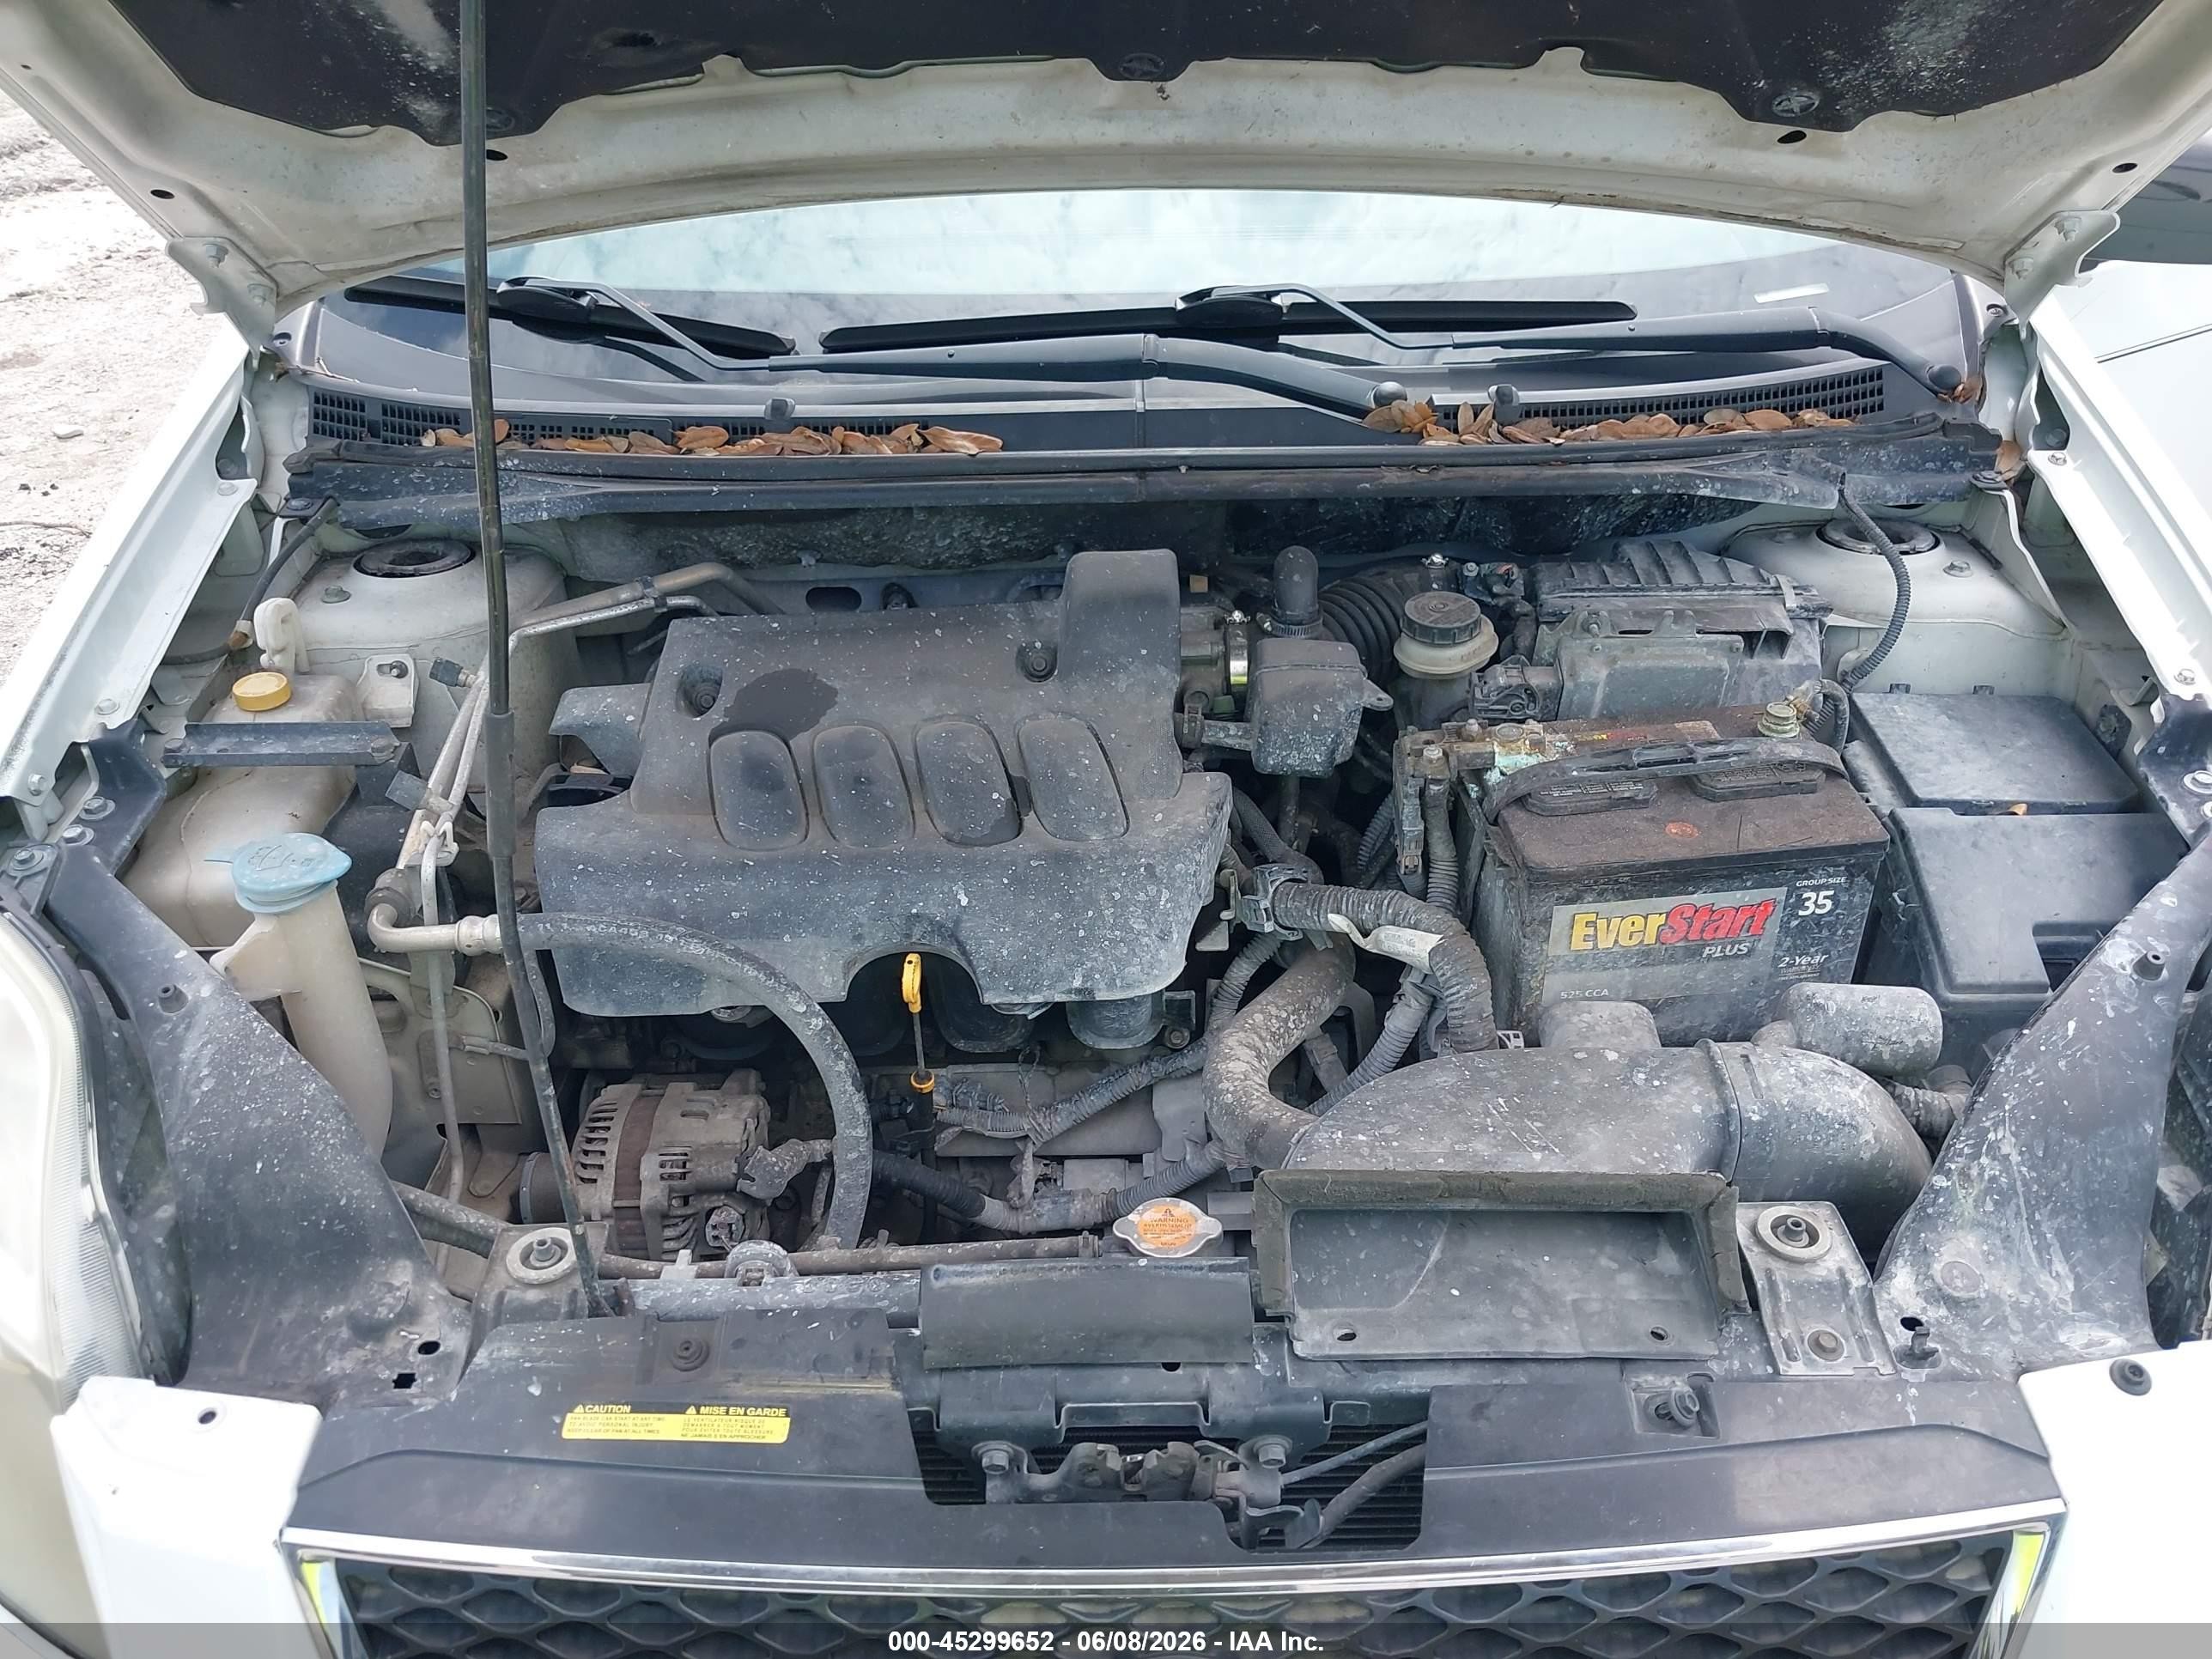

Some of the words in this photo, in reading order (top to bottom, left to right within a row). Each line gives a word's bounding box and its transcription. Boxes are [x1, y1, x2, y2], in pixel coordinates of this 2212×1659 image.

[1796, 878, 1826, 887] GROUP
[1798, 890, 1835, 916] 35
[1570, 898, 1777, 951] EverStart
[1702, 942, 1750, 958] PLUS
[1778, 954, 1829, 968] 2-Year
[1560, 990, 1583, 1000] 525
[1584, 988, 1609, 998] CCA
[585, 1404, 631, 1413] CAUTION
[699, 1405, 727, 1415] MISE
[728, 1407, 745, 1416] EN
[746, 1407, 787, 1417] GARDE
